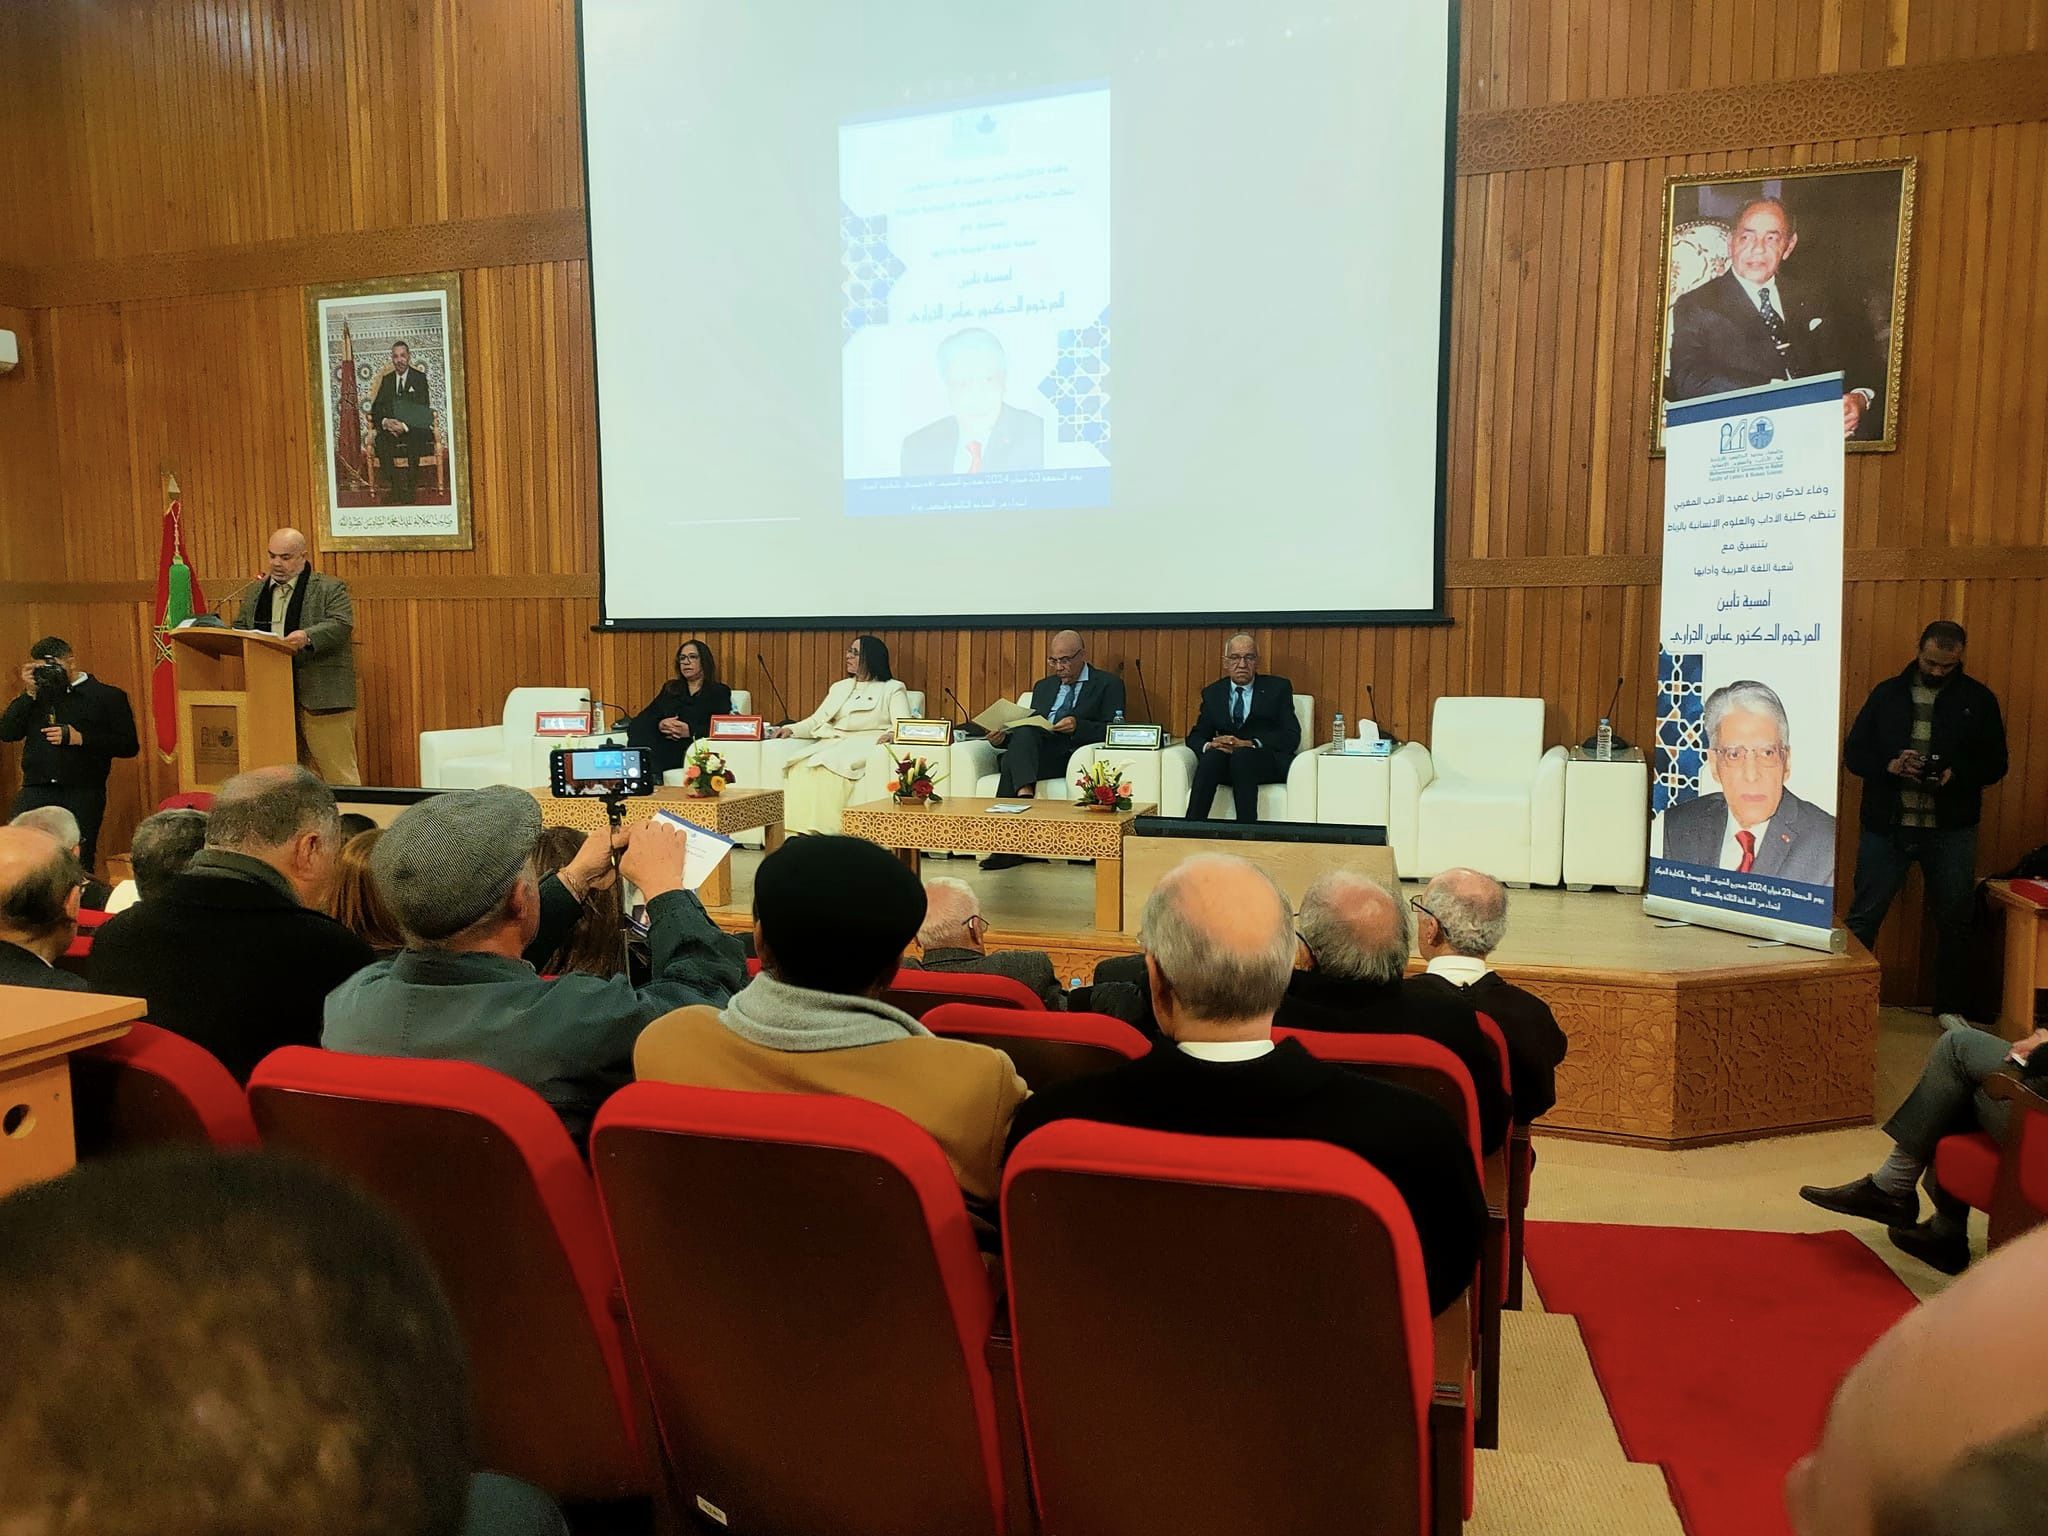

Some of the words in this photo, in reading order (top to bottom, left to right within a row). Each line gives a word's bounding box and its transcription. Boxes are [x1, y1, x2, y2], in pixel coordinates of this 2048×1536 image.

[1752, 491, 1774, 502] رحيل
[1806, 486, 1828, 496] وفاء
[1674, 497, 1702, 512] المغربي
[1726, 494, 1749, 503] عميد
[1722, 516, 1755, 528] والعلوم
[1784, 511, 1806, 522] كلية
[1808, 510, 1836, 522] تنظم
[1720, 544, 1734, 554] مع
[1736, 540, 1768, 552] بتنسيق
[1720, 564, 1748, 576] العربية
[1750, 562, 1770, 573] اللغة
[1773, 561, 1794, 572] شعبة
[1717, 590, 1740, 612] تأبين
[1742, 588, 1771, 610] أمسية
[1670, 623, 1704, 645] الجراري
[1705, 624, 1732, 645] عباس
[1736, 623, 1780, 645] الدكتور
[1782, 624, 1820, 645] المرحوم
[1748, 882, 1767, 892] 2024
[1780, 887, 1791, 896] 23
